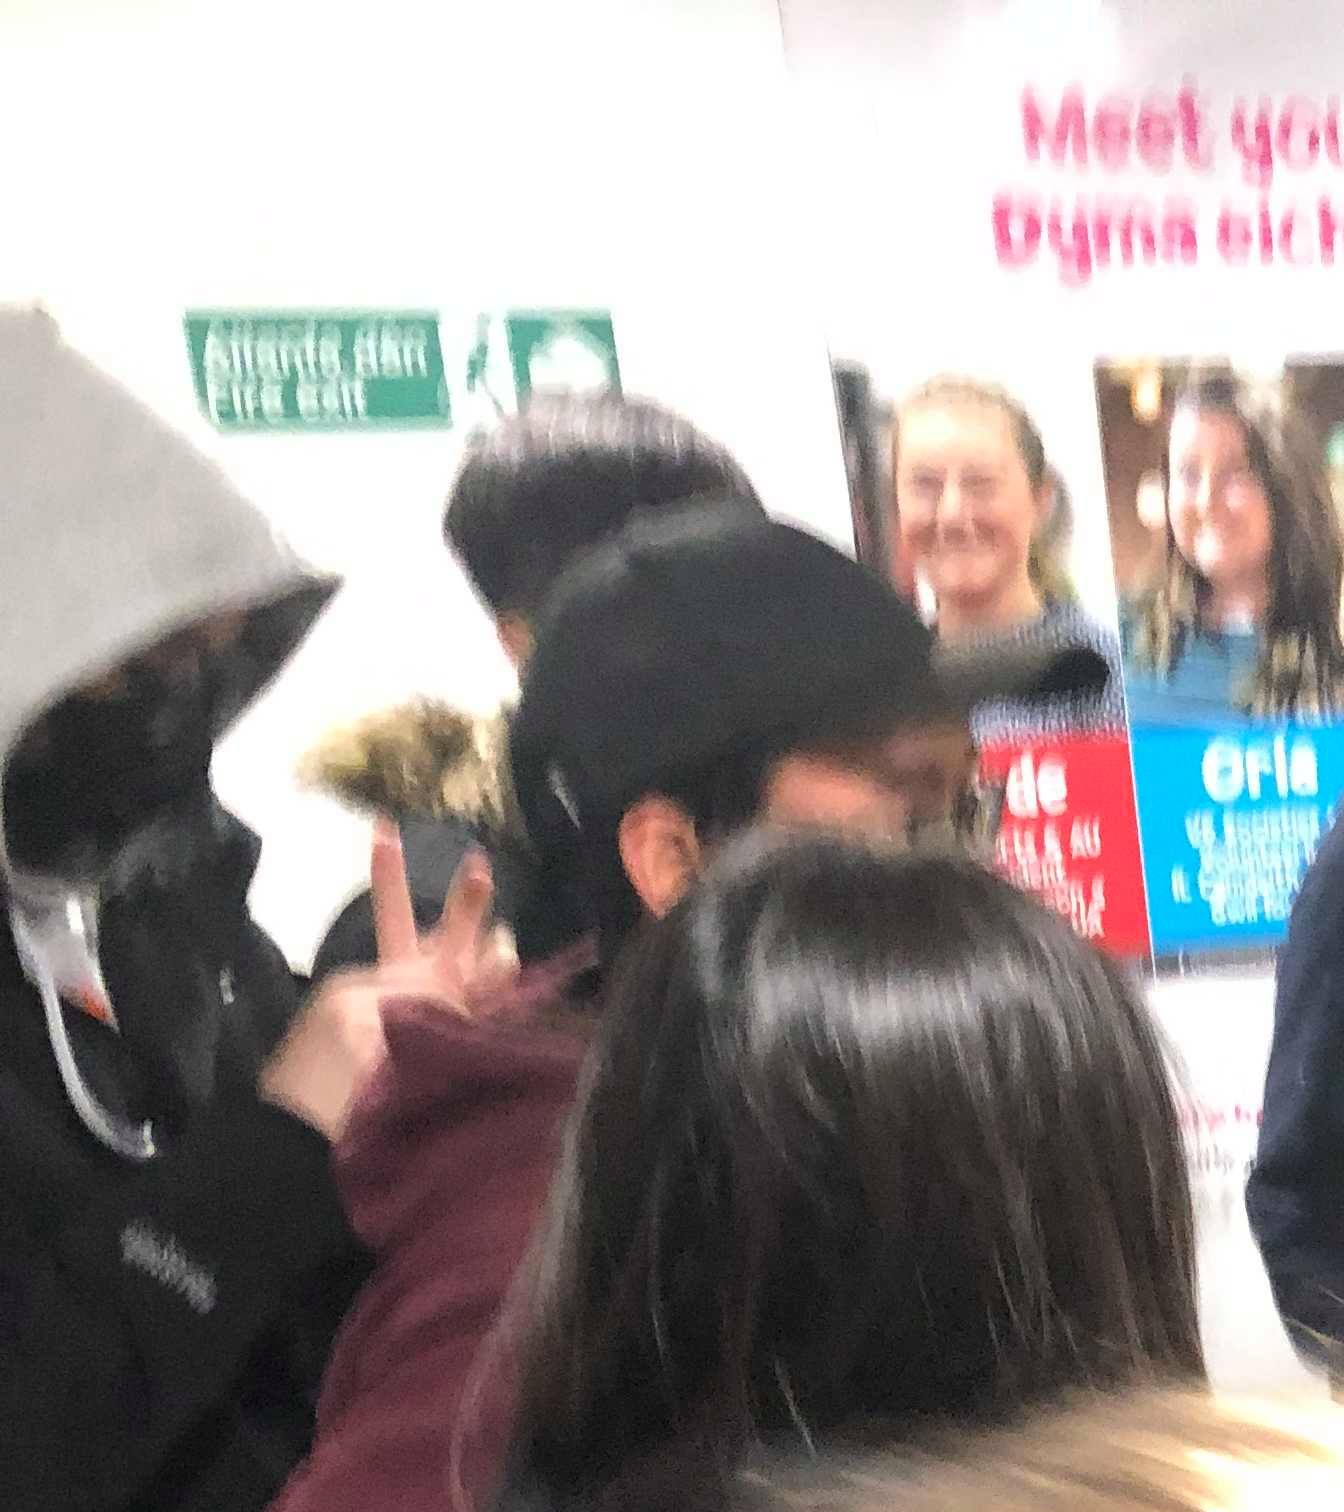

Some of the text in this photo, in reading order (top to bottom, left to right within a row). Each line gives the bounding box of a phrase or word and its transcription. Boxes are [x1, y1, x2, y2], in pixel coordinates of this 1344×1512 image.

[1021, 80, 1214, 172] Meet
[993, 193, 1198, 288] Dyma
[1202, 732, 1319, 803] Orla
